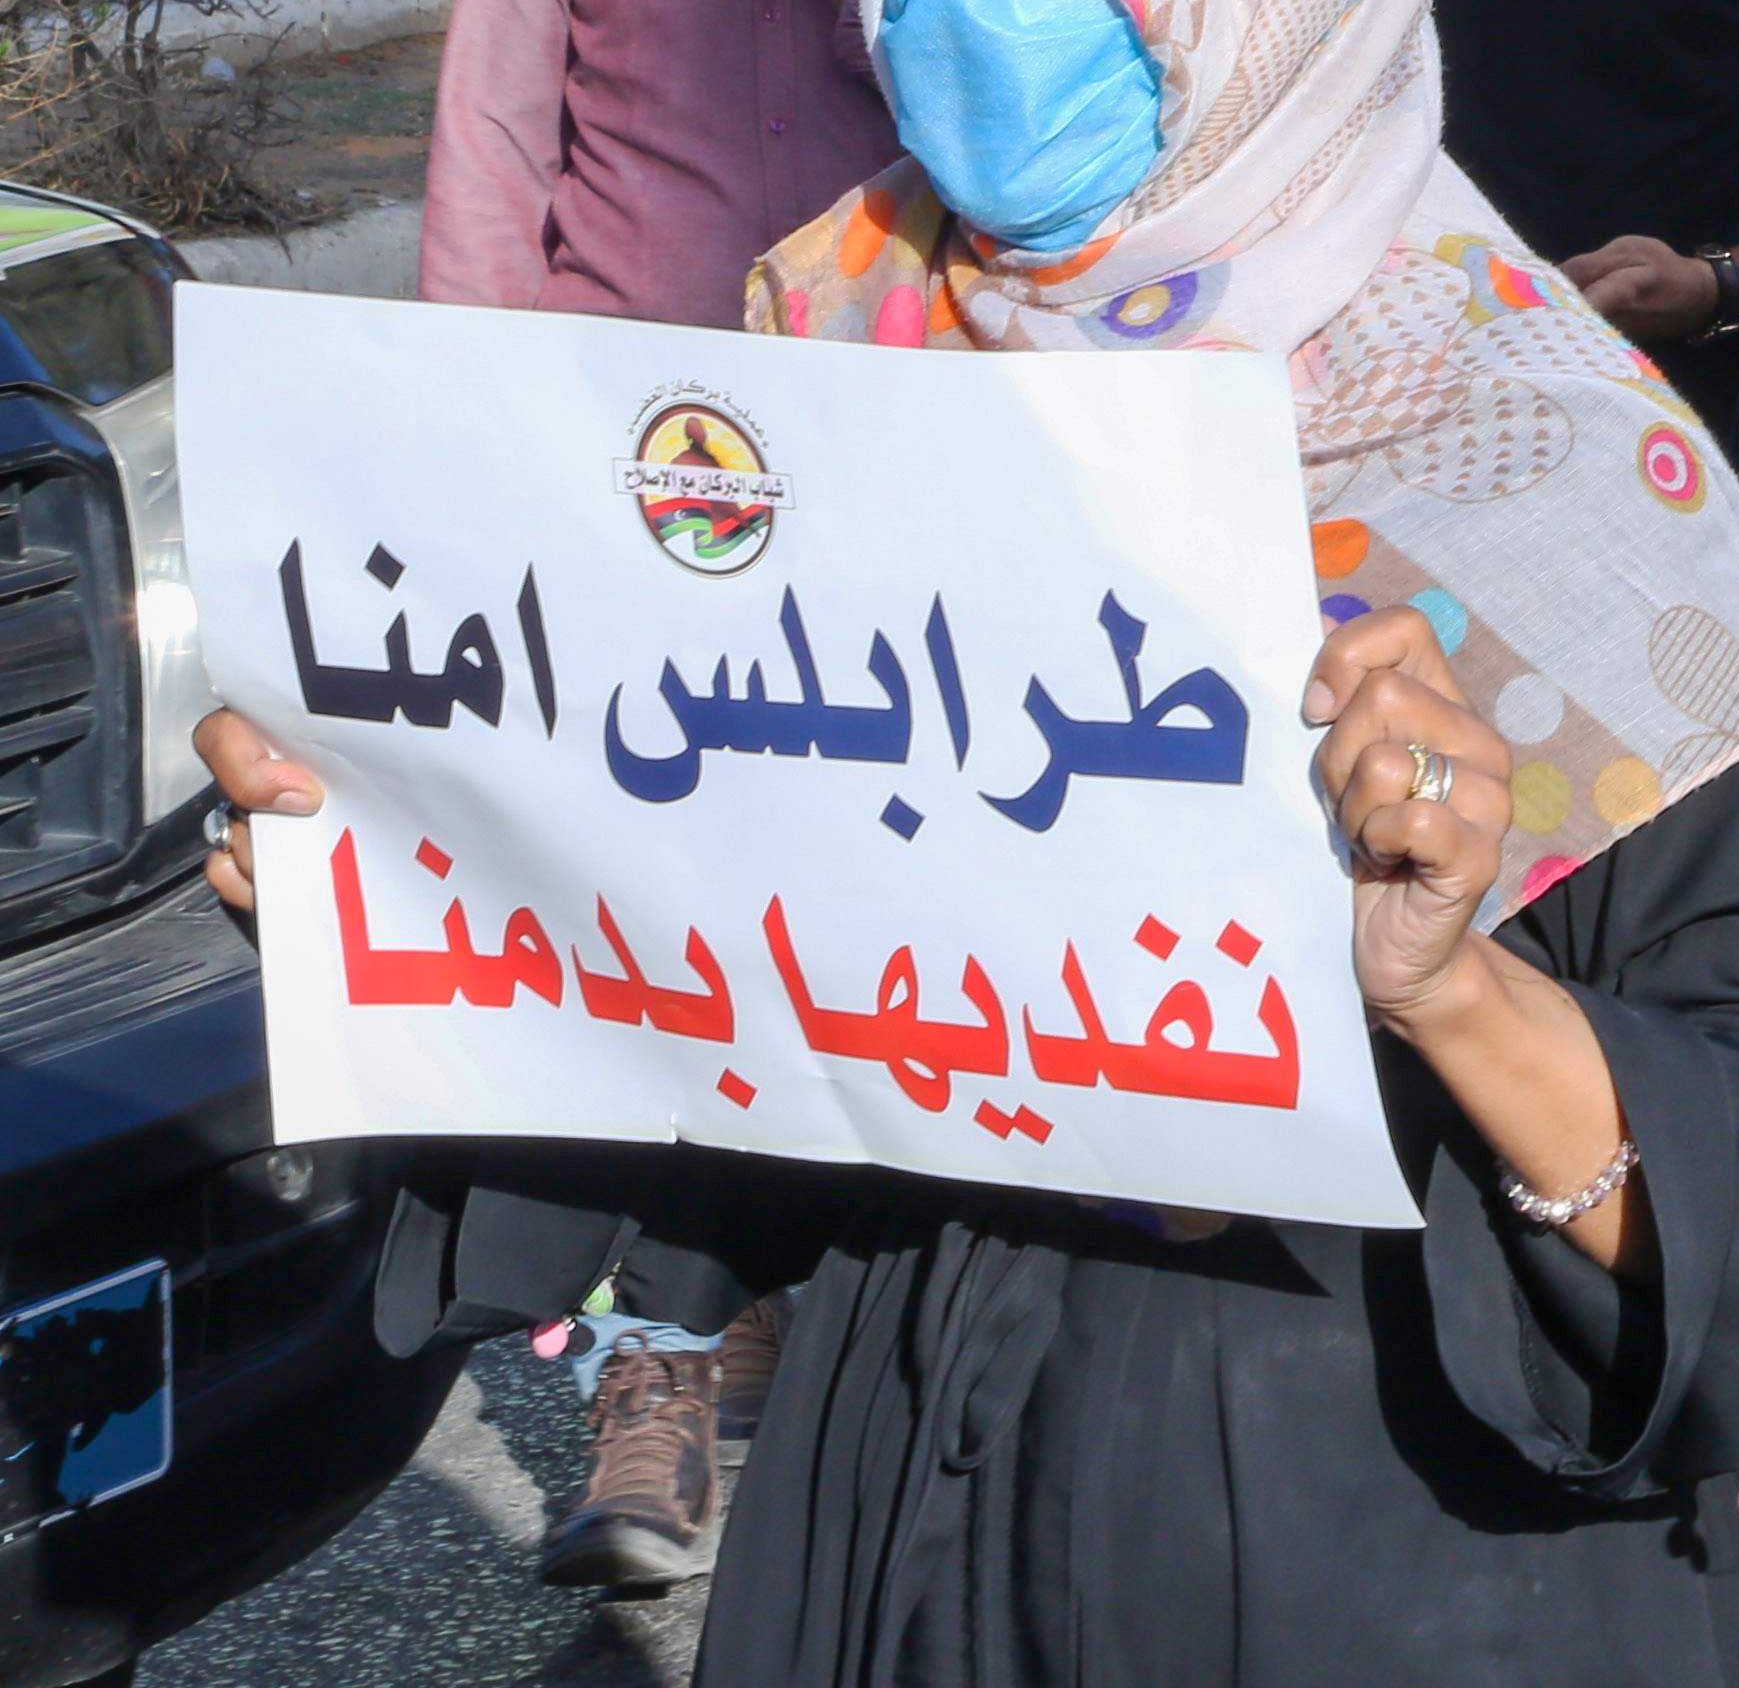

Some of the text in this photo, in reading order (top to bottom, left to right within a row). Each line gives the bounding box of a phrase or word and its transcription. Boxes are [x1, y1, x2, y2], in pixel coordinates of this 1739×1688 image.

[279, 536, 1250, 843] طرابلس امنا
[330, 826, 1303, 1146] نفديها بدمنا
